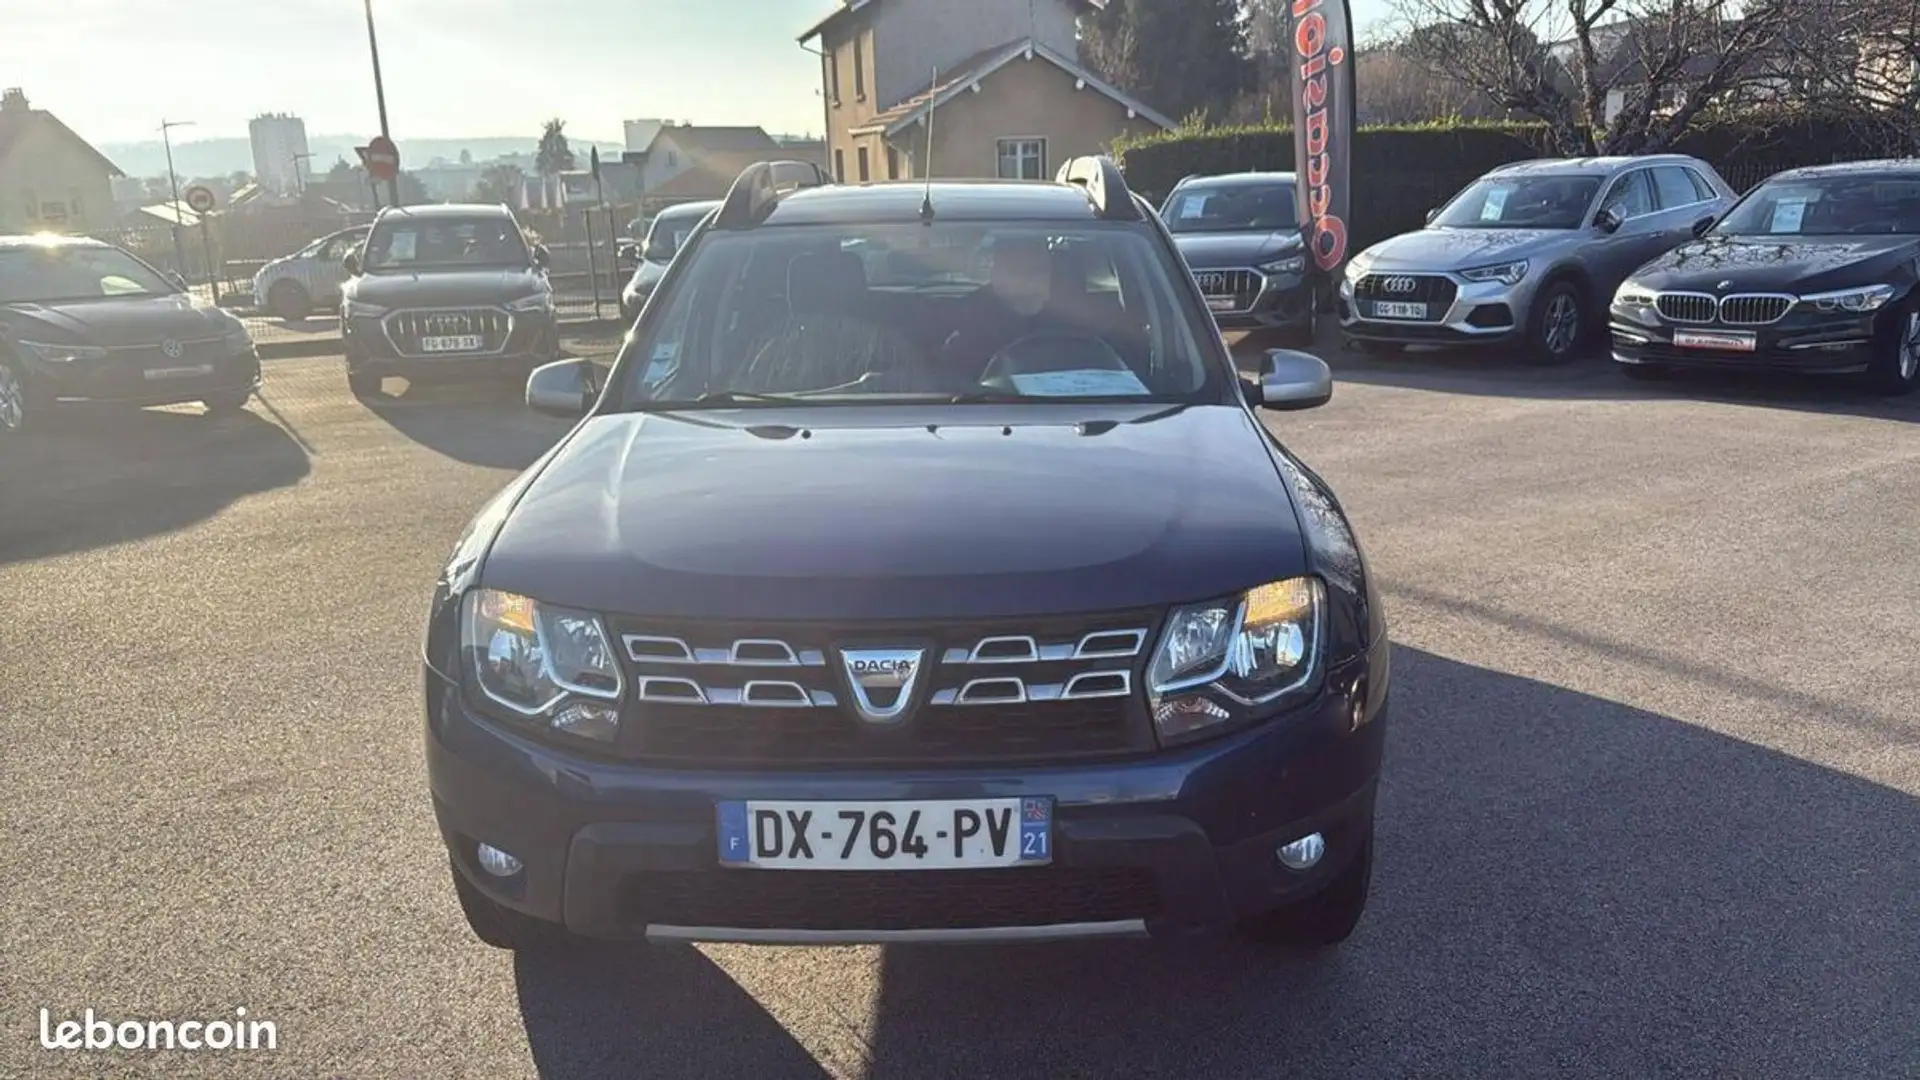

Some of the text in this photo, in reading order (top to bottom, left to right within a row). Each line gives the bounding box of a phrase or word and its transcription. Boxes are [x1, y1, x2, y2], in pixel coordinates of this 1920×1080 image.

[854, 660, 911, 671] DACIA
[730, 808, 1046, 859] F DX-764-PV 21
